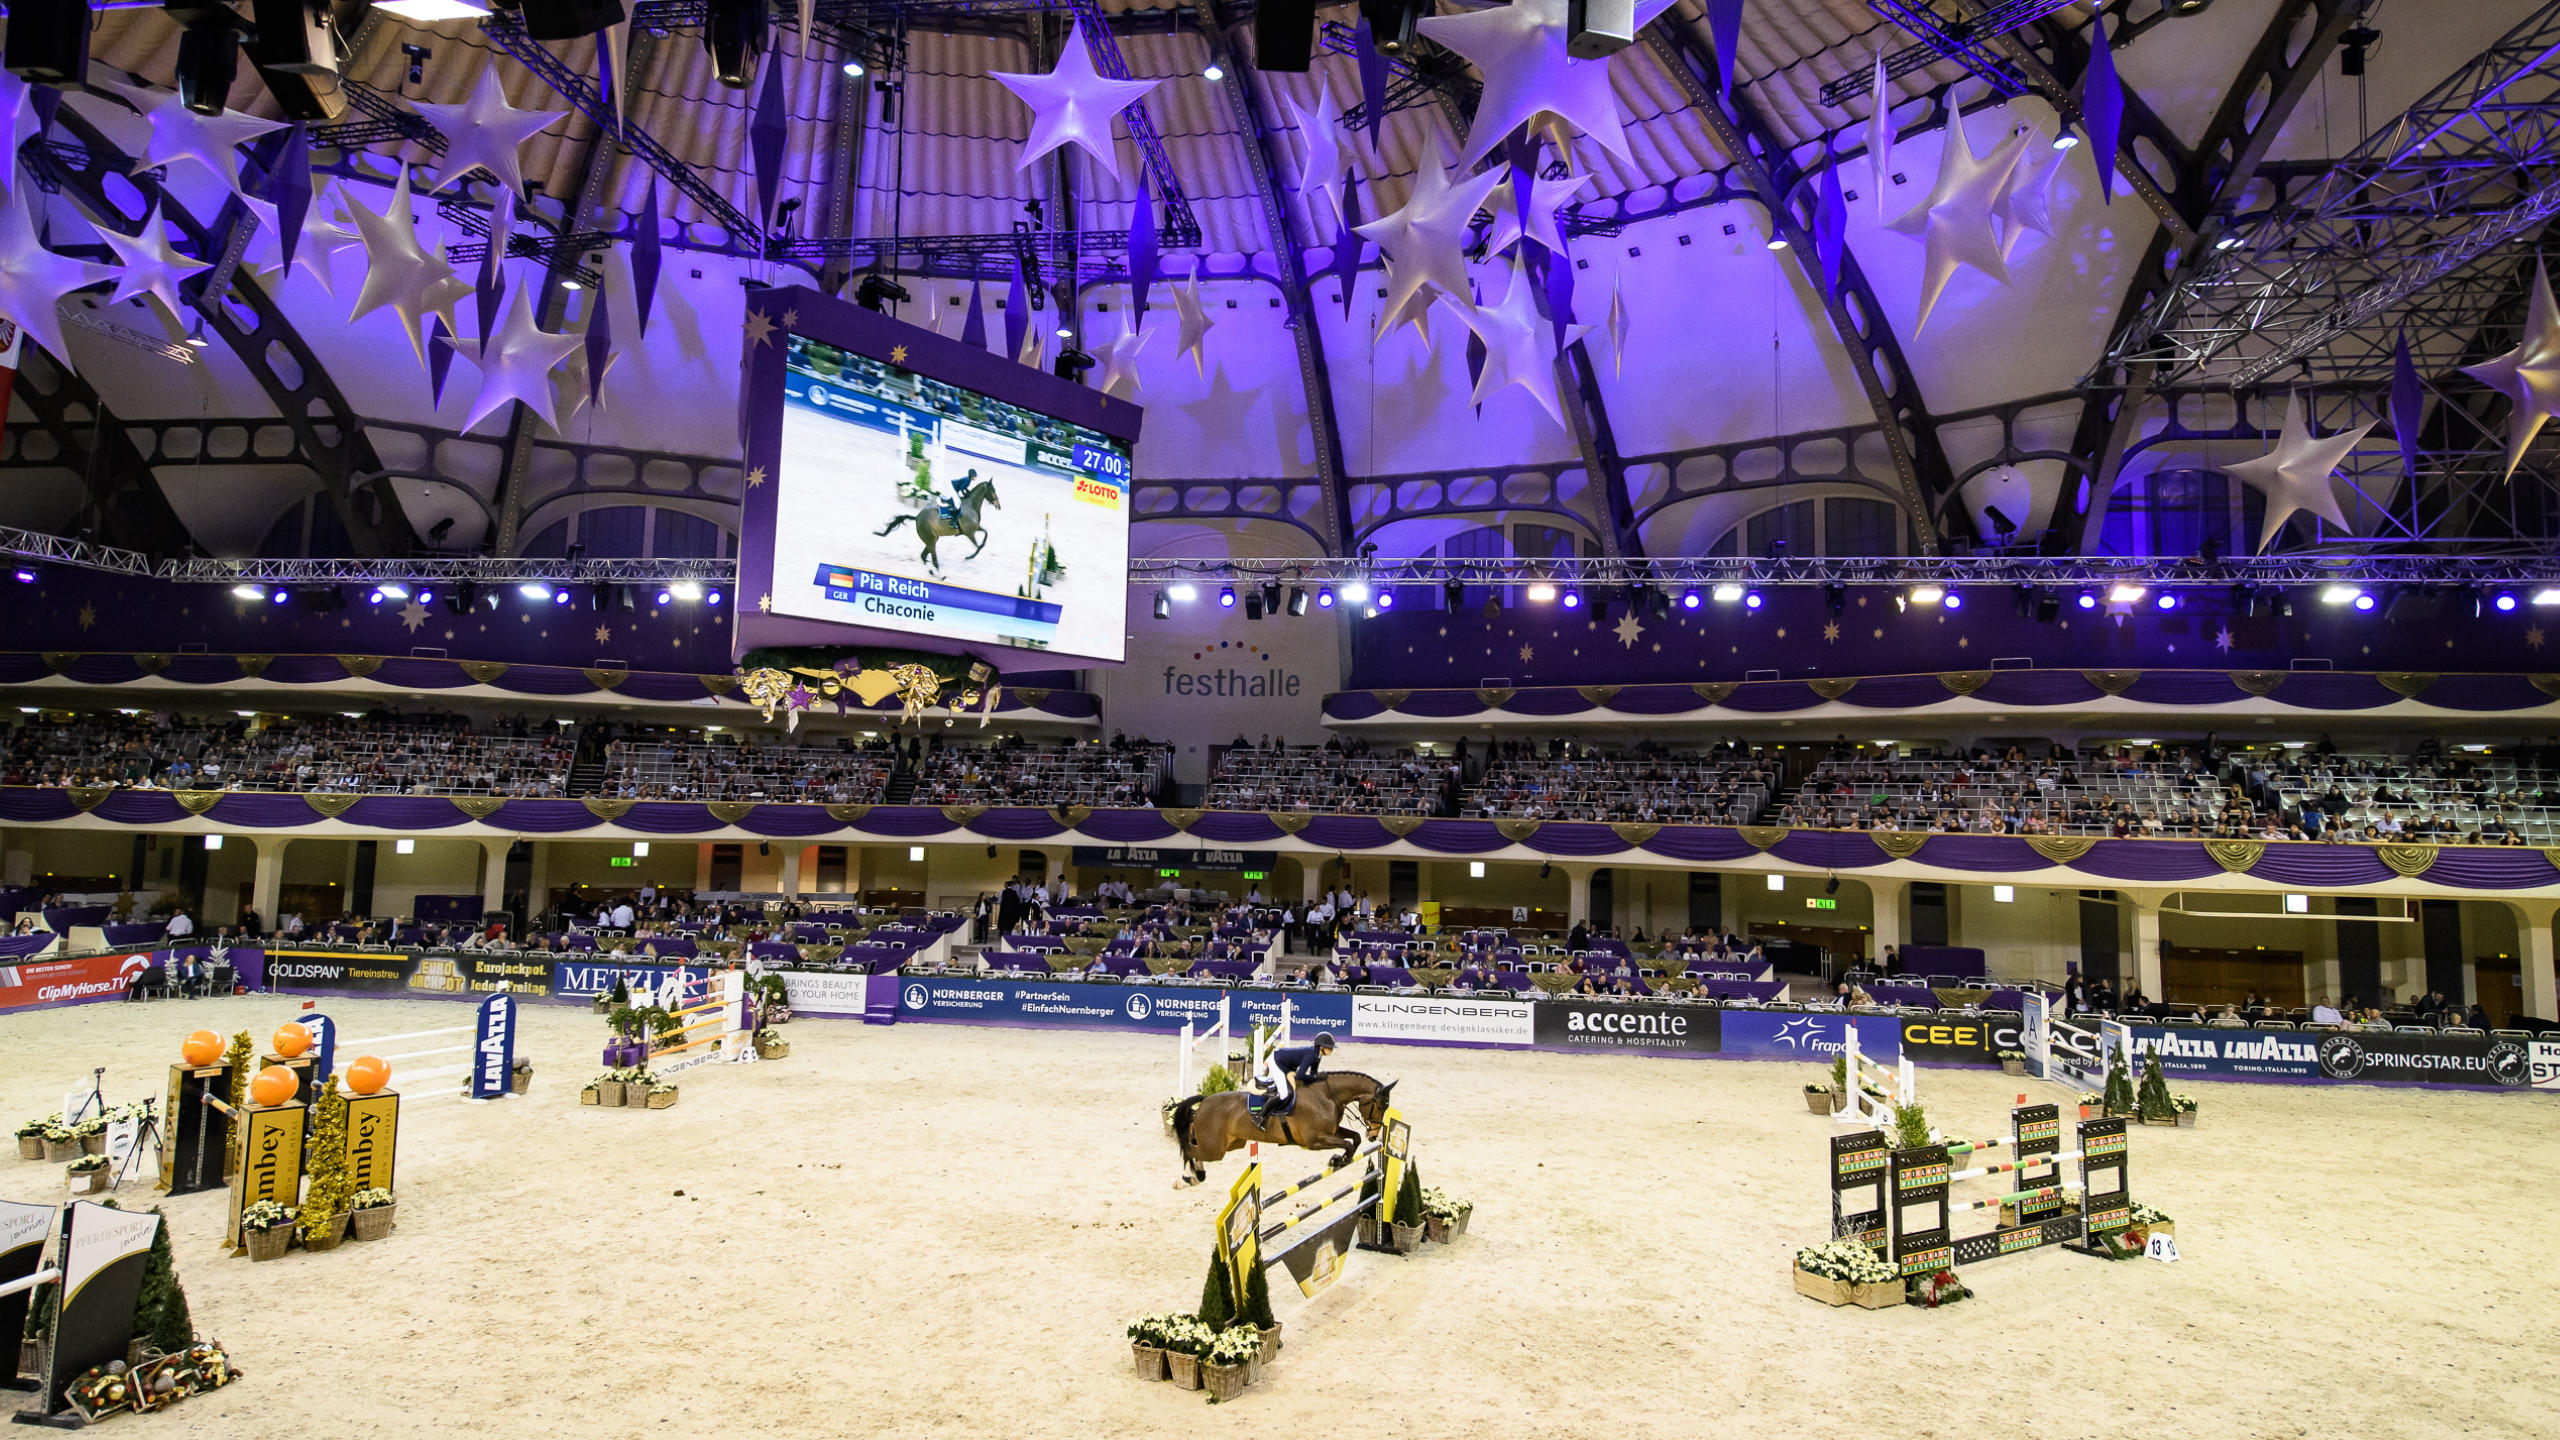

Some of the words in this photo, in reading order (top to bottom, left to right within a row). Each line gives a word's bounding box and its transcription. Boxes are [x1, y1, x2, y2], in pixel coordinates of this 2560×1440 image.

[1083, 449, 1121, 475] 27.00
[1089, 484, 1118, 500] LOTTO
[860, 572, 883, 591] Pia
[888, 577, 929, 599] Reich
[833, 591, 848, 600] GER
[864, 597, 935, 621] Chaconie
[1163, 666, 1300, 697] festhalle
[1107, 847, 1158, 861] LAAZZA
[1192, 850, 1244, 863] LVAZZA
[1515, 908, 1525, 920] A
[348, 968, 400, 979] Tiereinstreu
[476, 961, 548, 977] Eurojackpot.
[38, 976, 128, 1001] ClipMyHorse.TV
[410, 973, 465, 992] JACKPOT
[505, 980, 549, 997] Freitag.
[785, 978, 819, 988] BRINGS
[822, 980, 860, 990] BEAUTY
[802, 990, 827, 999] YOUR
[830, 991, 859, 1000] HOME
[933, 988, 1004, 1001] NÜRNBERGER
[1015, 991, 1070, 1002] #PartnerSein
[1156, 998, 1222, 1010] NÜRNBERGE
[1241, 1001, 1299, 1011] #Partnerin
[1358, 1003, 1528, 1018] KLINGENBERG
[1156, 1010, 1208, 1018] VERSICHUNG
[1358, 1020, 1528, 1035] www.klingenberg-designklassiker.de
[1568, 1011, 1686, 1035] accente
[2029, 1016, 2037, 1040] A
[480, 996, 508, 1090] LAVAZZA
[1568, 1034, 1614, 1044] CATERING
[1627, 1038, 1687, 1048] HOSPITALITY
[1905, 1024, 1978, 1046] CEE
[742, 1050, 748, 1060] C
[1811, 1038, 1858, 1056] Frapo
[2224, 1036, 2318, 1062] LAVAZZA
[2082, 1056, 2092, 1067] by
[2365, 1052, 2487, 1071] SPRINGSTAR.EU
[352, 1112, 380, 1193] ambey
[1840, 1150, 1884, 1163] SPIELBANK
[1901, 1167, 1946, 1180] SPIELBANK
[2152, 1238, 2161, 1255] 13
[1903, 1249, 1948, 1265] SPIELBANK
[1903, 1258, 1948, 1274] WIESBADEN
